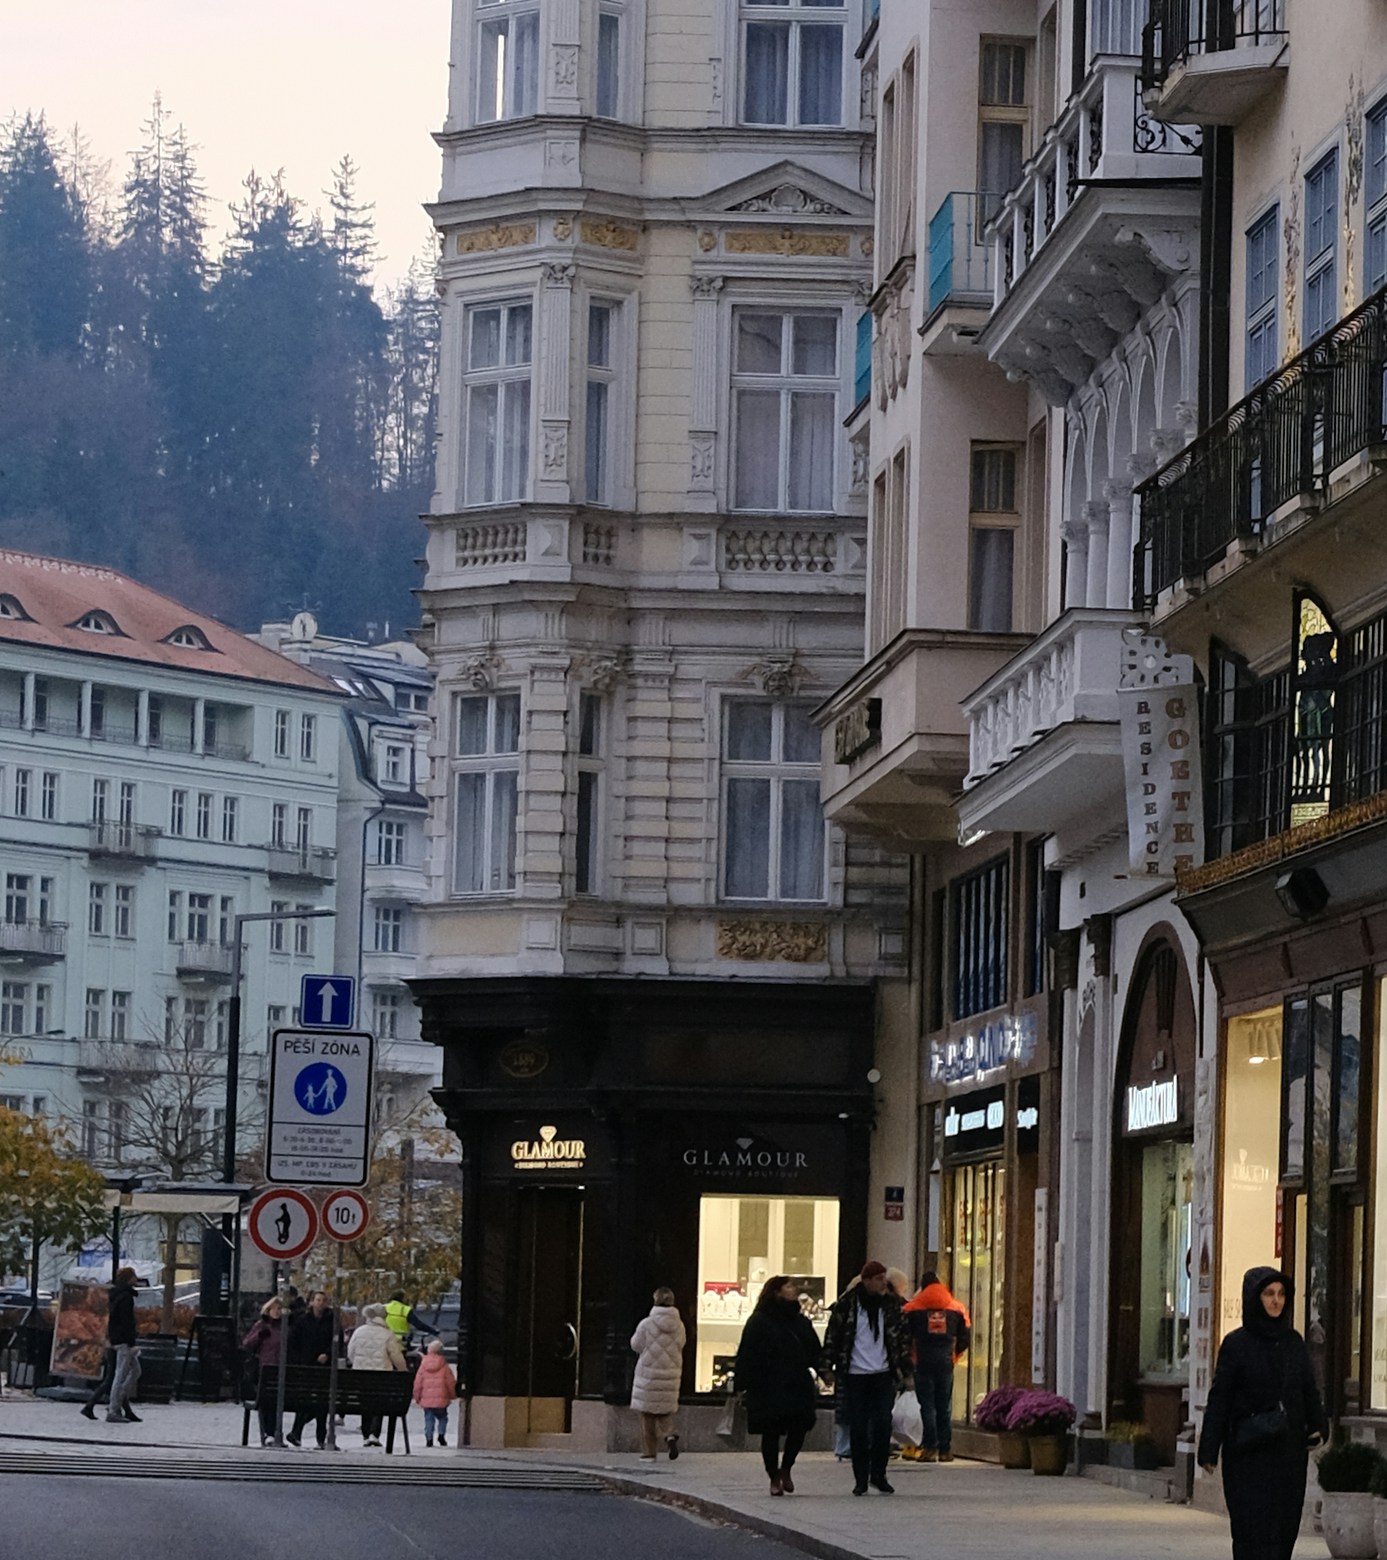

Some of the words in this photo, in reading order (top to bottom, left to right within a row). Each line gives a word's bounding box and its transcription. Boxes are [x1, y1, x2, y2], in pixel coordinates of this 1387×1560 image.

[1137, 701, 1160, 874] RESIDENCE
[1165, 698, 1195, 873] GOETHE
[283, 1039, 315, 1054] PĚŠÍ
[321, 1039, 361, 1056] ZÓNA
[511, 1140, 586, 1160] GLAMOUR
[683, 1149, 808, 1168] GLAMOUR
[334, 1207, 349, 1225] 10
